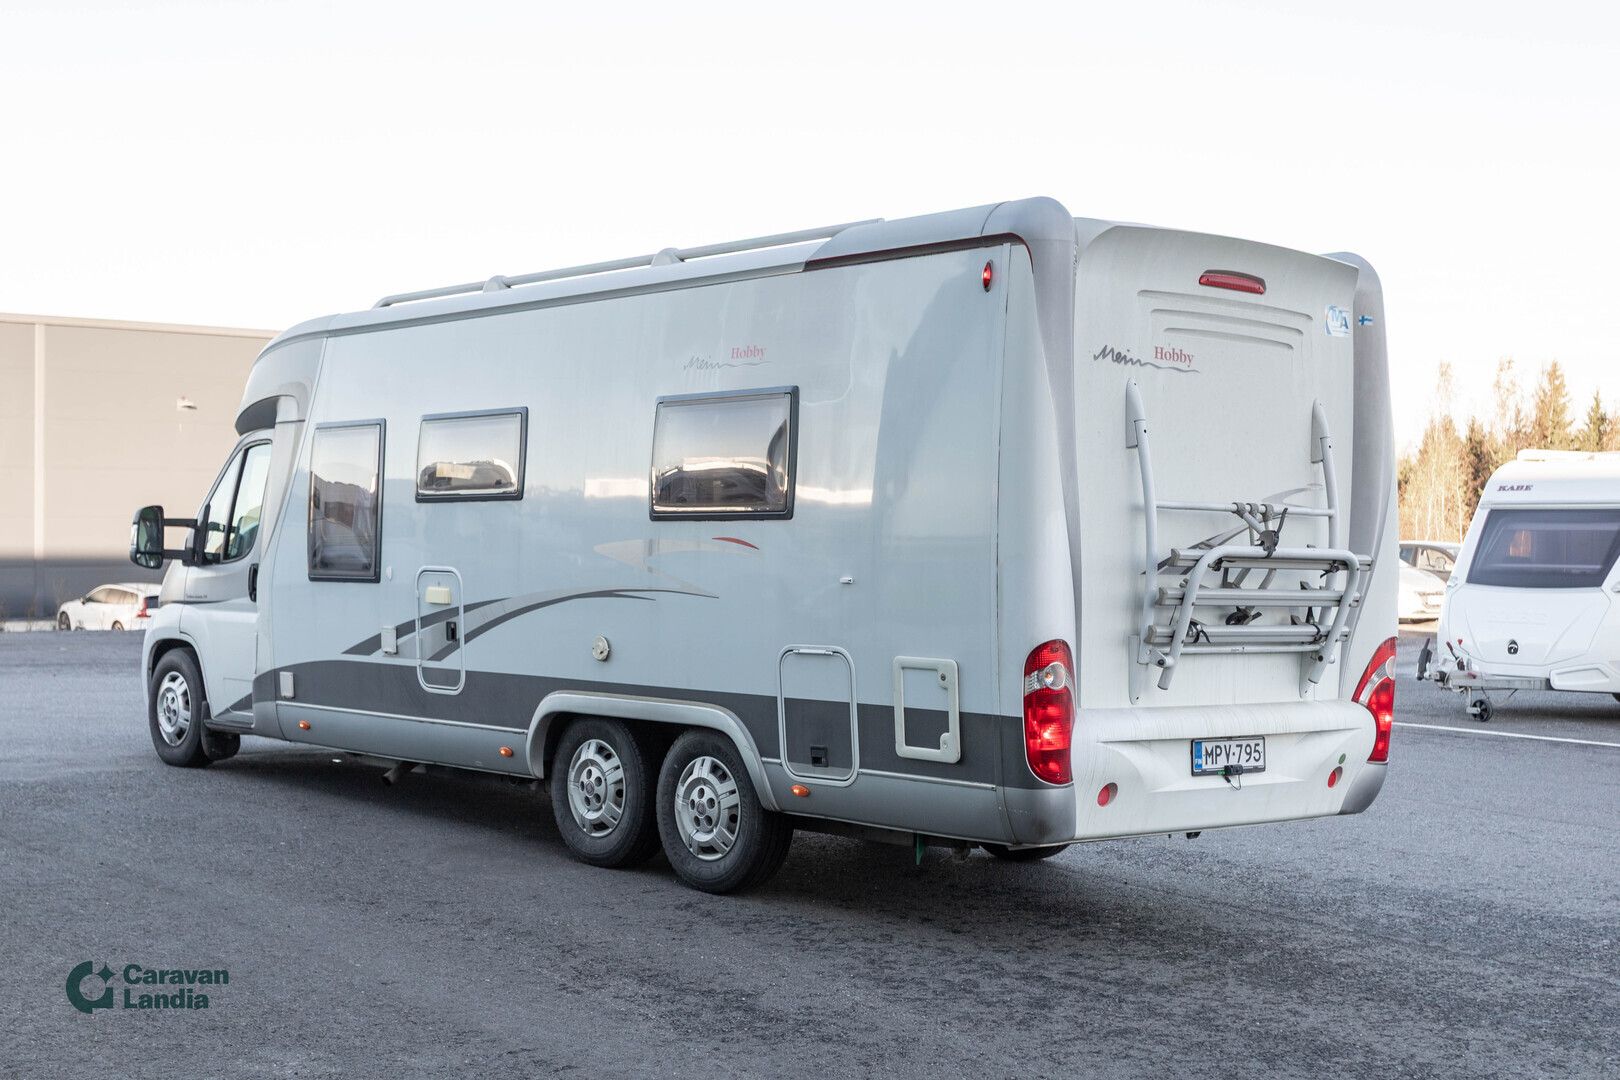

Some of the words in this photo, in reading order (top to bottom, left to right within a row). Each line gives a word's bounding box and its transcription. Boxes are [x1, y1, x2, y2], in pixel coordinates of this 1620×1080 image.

[683, 355, 721, 371] Mein
[731, 345, 767, 361] Hobby
[1093, 344, 1143, 366] Mein
[1154, 346, 1194, 368] Hobby
[1204, 743, 1261, 765] MPV-795
